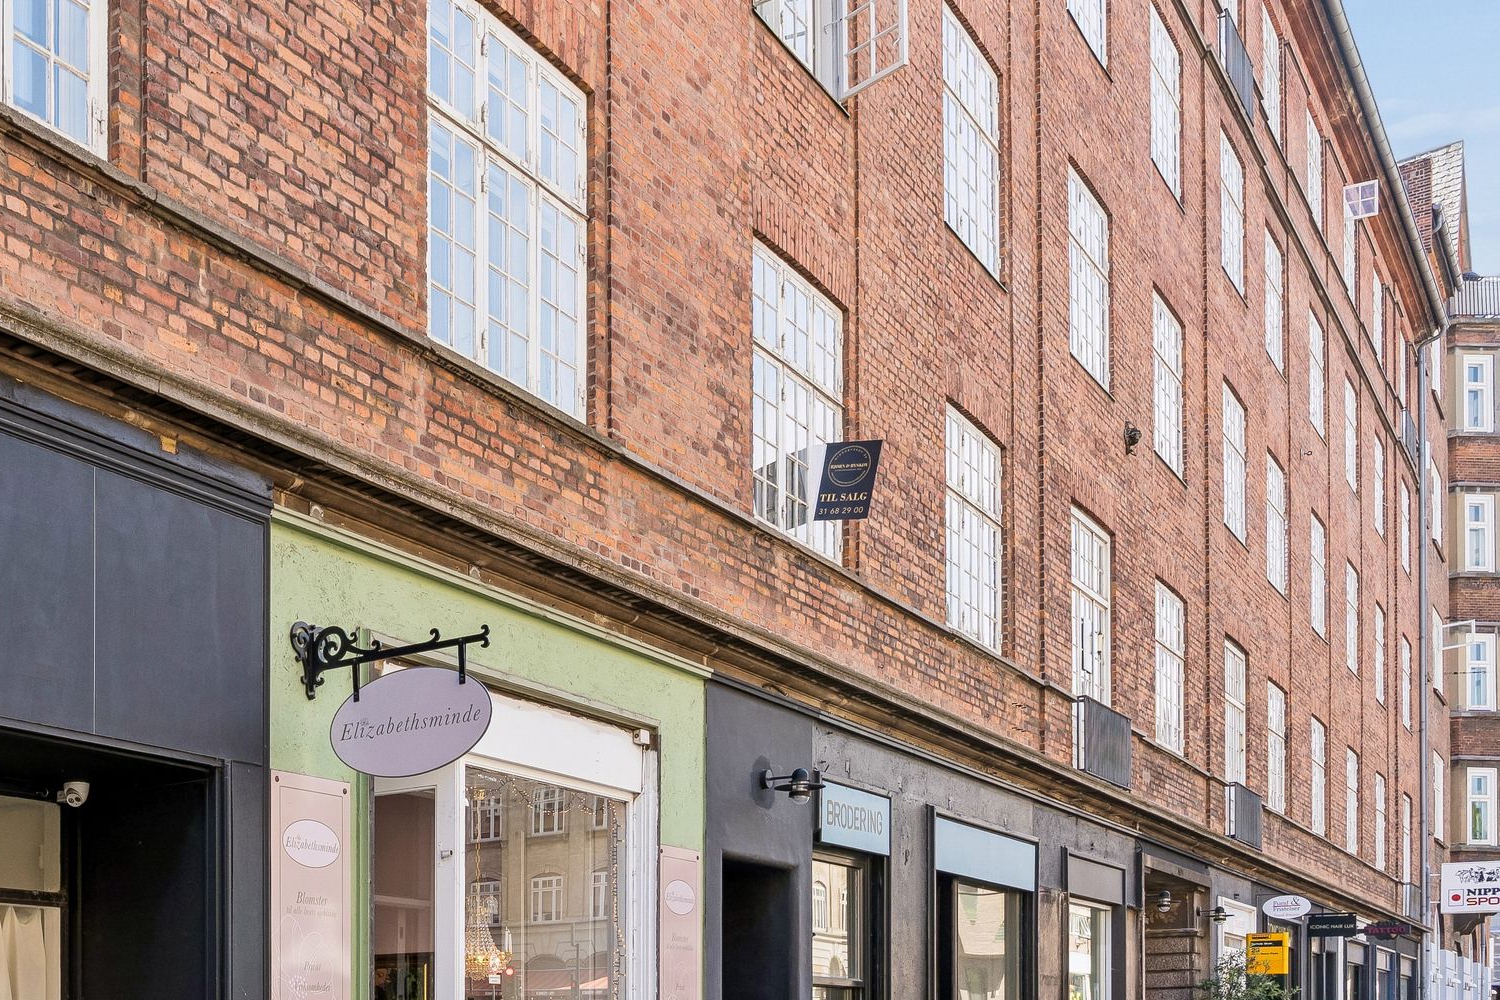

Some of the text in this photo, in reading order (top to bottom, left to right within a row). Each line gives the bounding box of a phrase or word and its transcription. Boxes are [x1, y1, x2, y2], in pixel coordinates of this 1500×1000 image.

[820, 492, 868, 502] TIL SALG
[340, 704, 482, 742] Elizabethsminde
[826, 799, 883, 836] BRODERING
